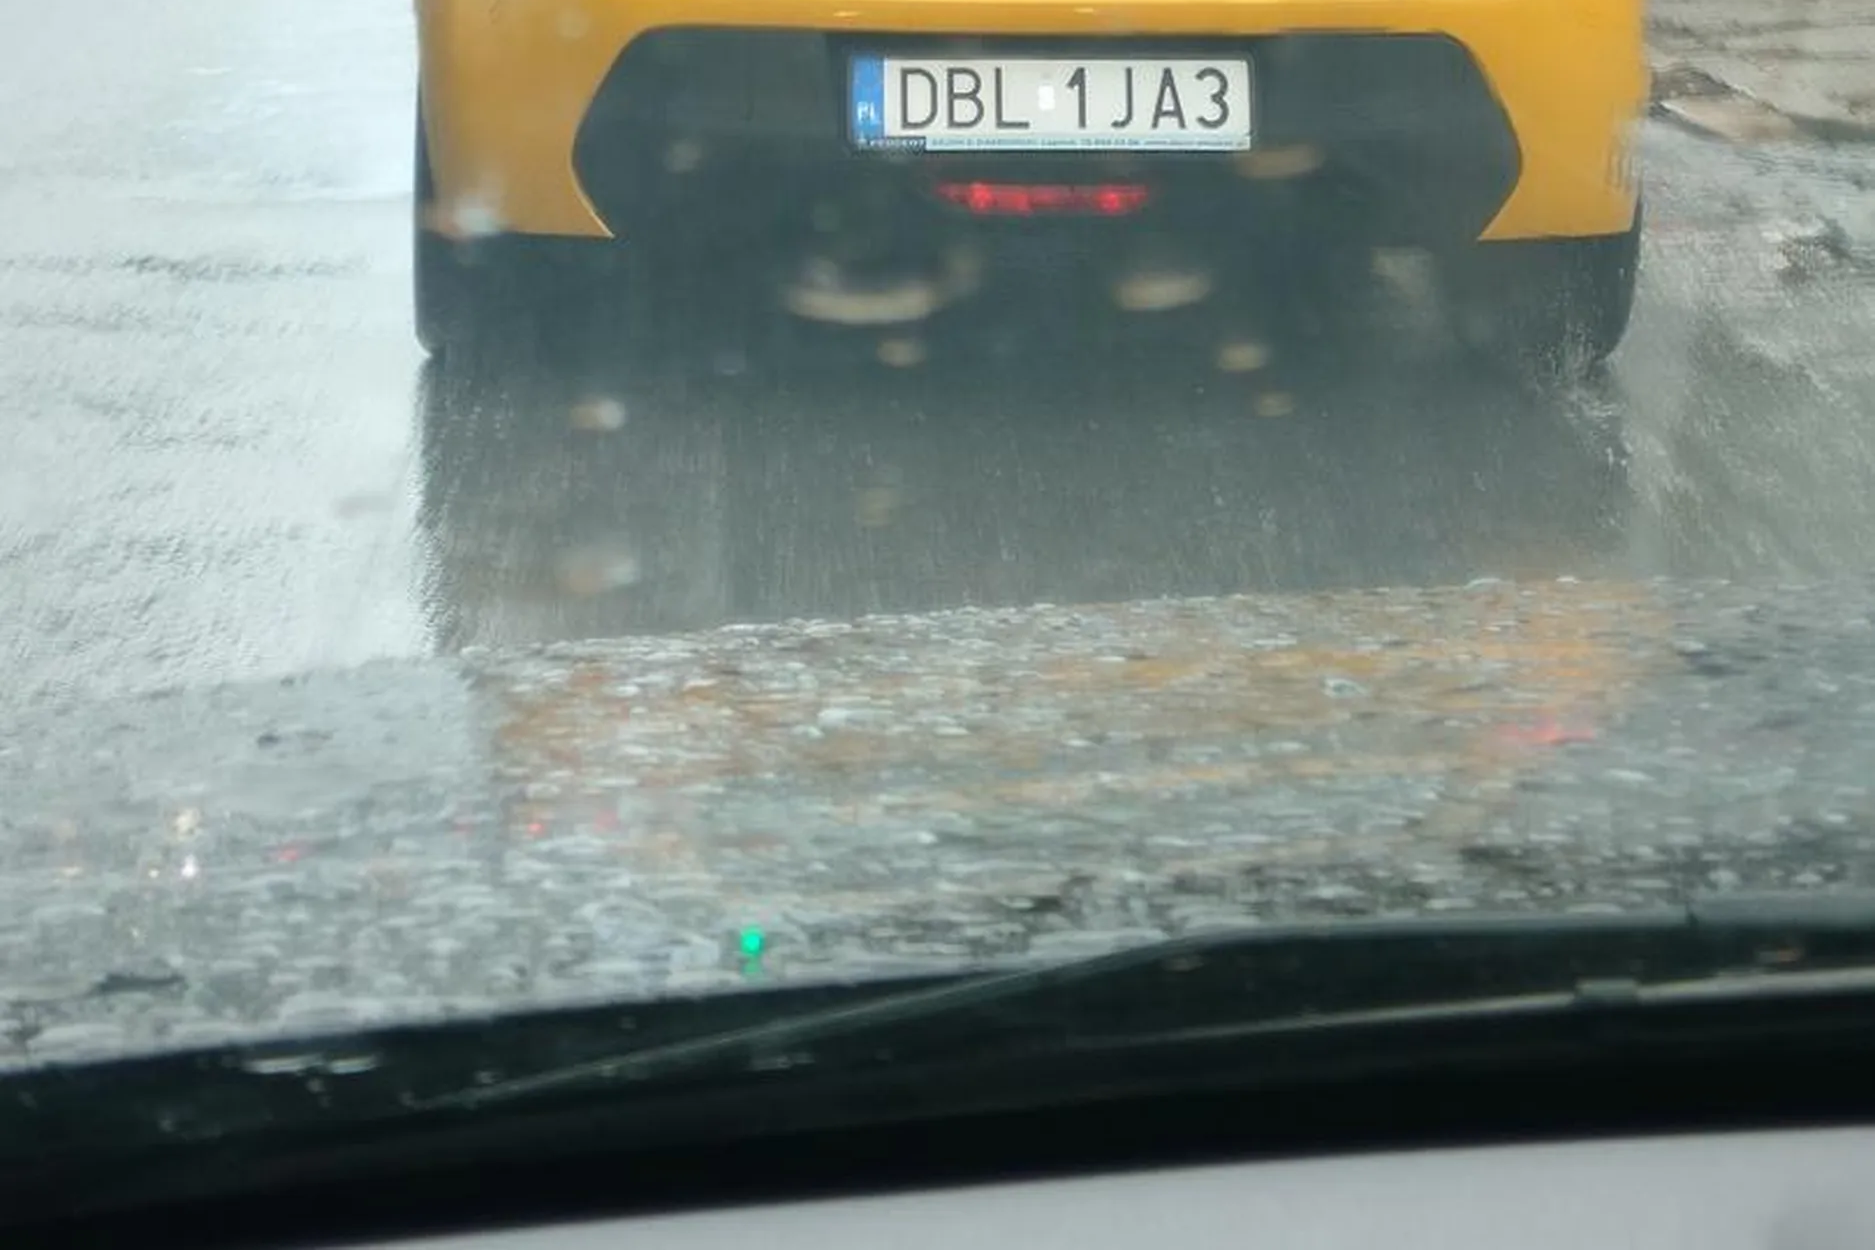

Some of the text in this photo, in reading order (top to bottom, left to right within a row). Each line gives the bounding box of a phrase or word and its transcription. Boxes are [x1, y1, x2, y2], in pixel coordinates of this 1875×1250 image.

[857, 101, 880, 125] PL
[901, 67, 1230, 129] DBL 1JA3
